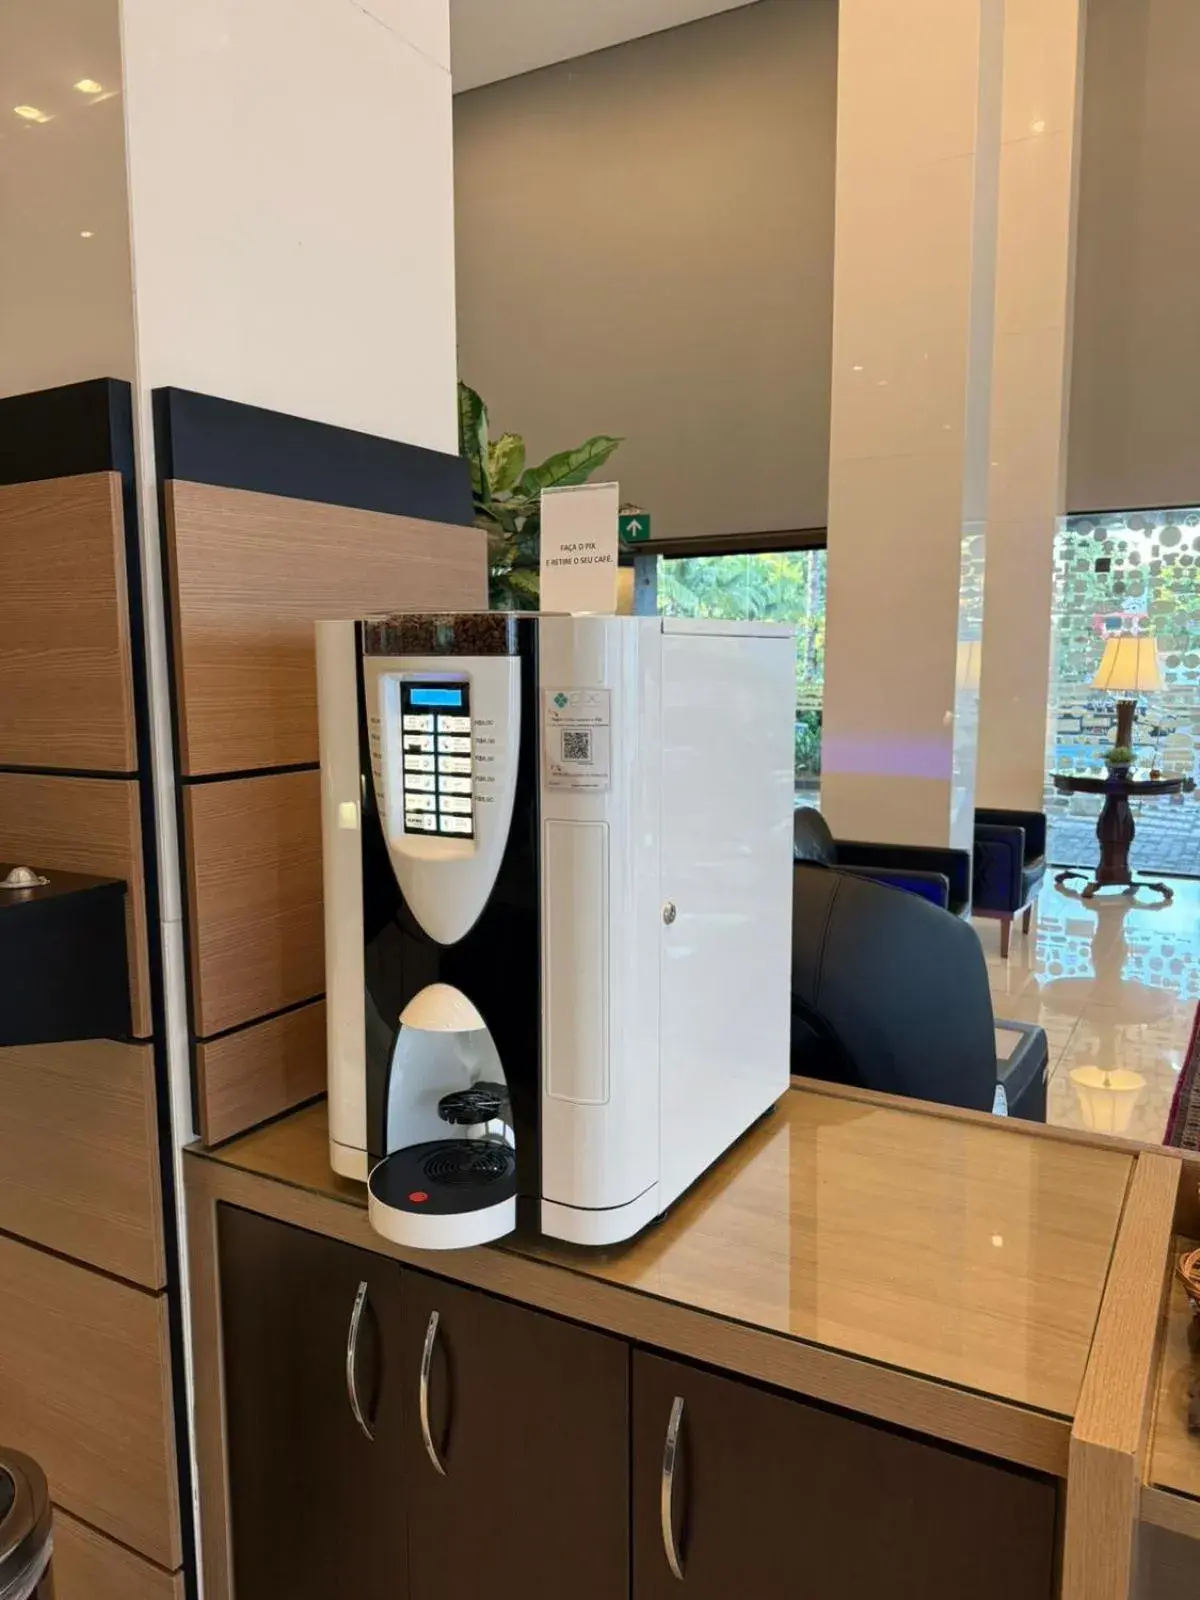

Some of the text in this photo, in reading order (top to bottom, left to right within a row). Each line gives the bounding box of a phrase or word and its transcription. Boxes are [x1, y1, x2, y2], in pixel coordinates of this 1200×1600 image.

[560, 543, 577, 552] FAÇA
[578, 543, 584, 551] O
[551, 558, 572, 566] RETIRE
[573, 557, 579, 565] O
[580, 556, 593, 564] SEU
